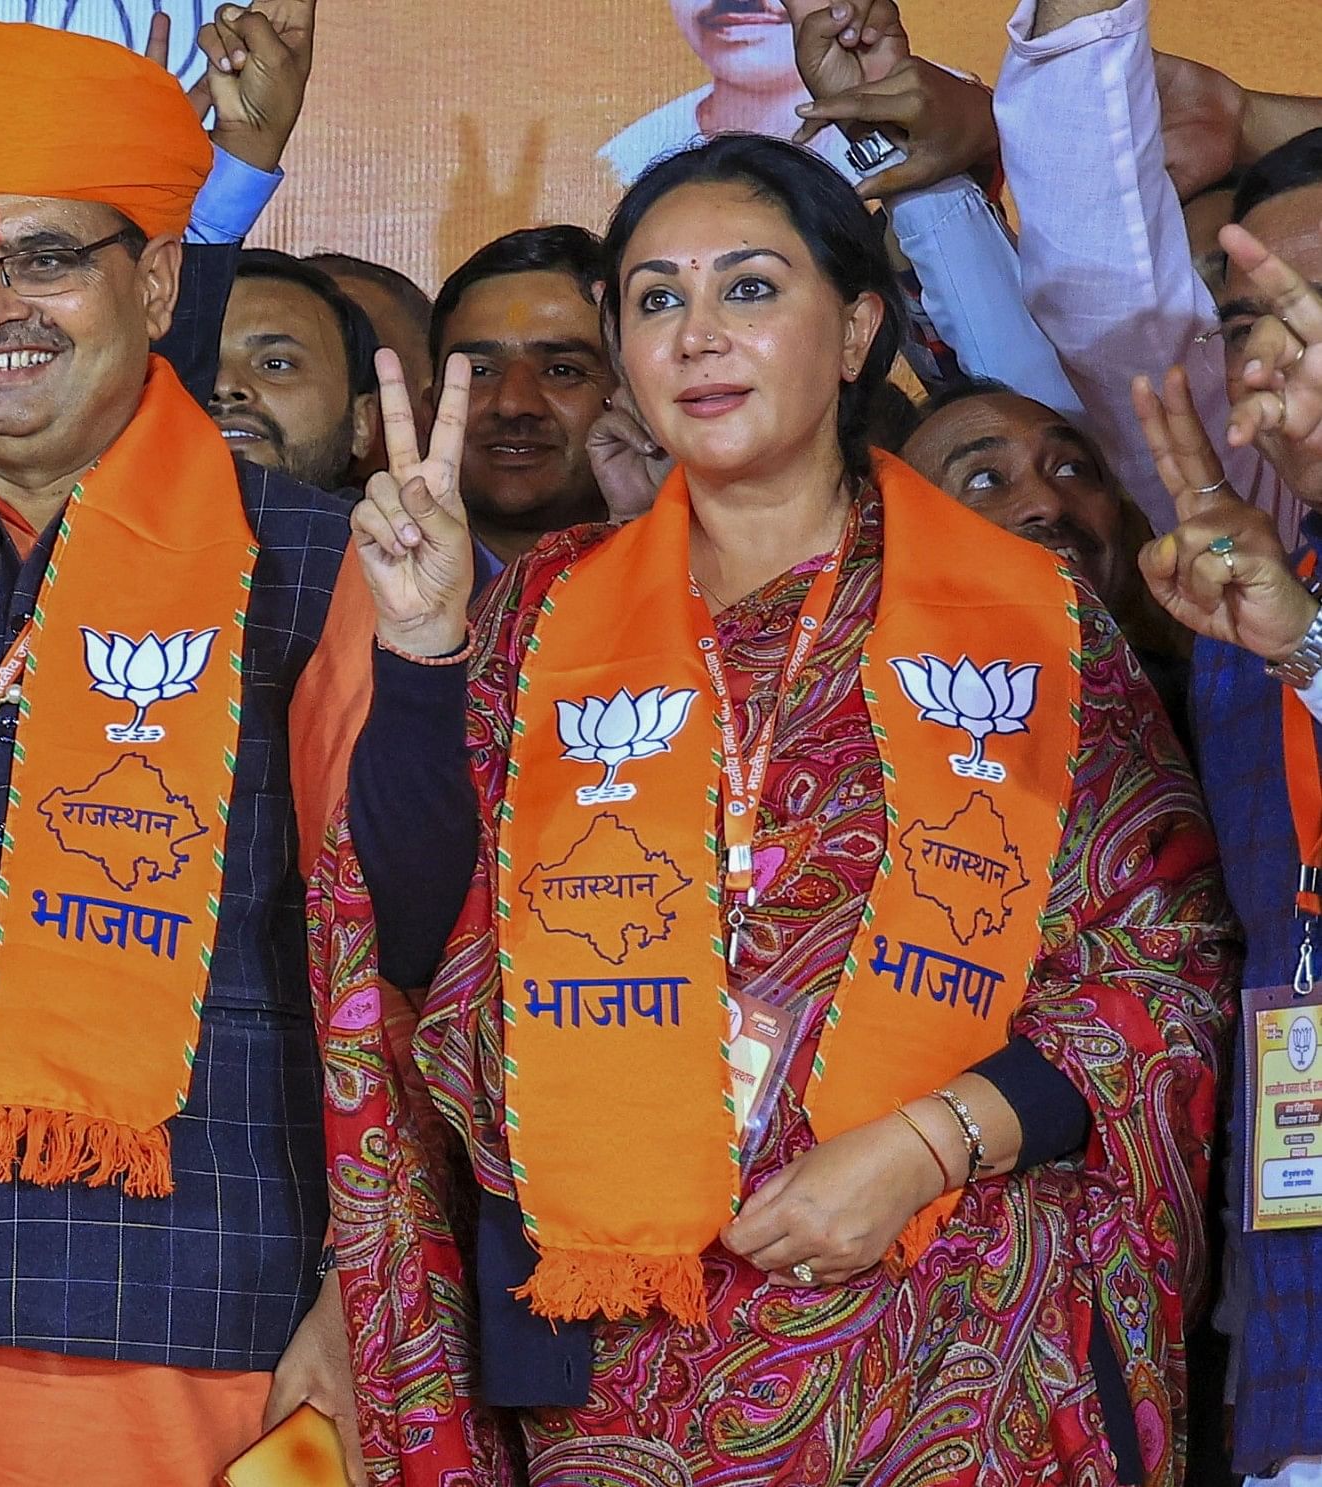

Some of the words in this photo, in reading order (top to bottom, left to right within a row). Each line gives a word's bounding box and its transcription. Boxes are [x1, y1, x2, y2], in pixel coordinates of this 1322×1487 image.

[785, 630, 812, 682] राजस्थान
[722, 757, 744, 796] भारतीय
[746, 744, 767, 790] भारतीय
[62, 802, 178, 838] राजस्थान
[541, 873, 659, 901] राजस्थान
[921, 838, 1010, 888] राजस्थान
[31, 889, 193, 961] भाजपा
[524, 976, 692, 1029] भाजपा
[869, 934, 1006, 1021] भाजपा
